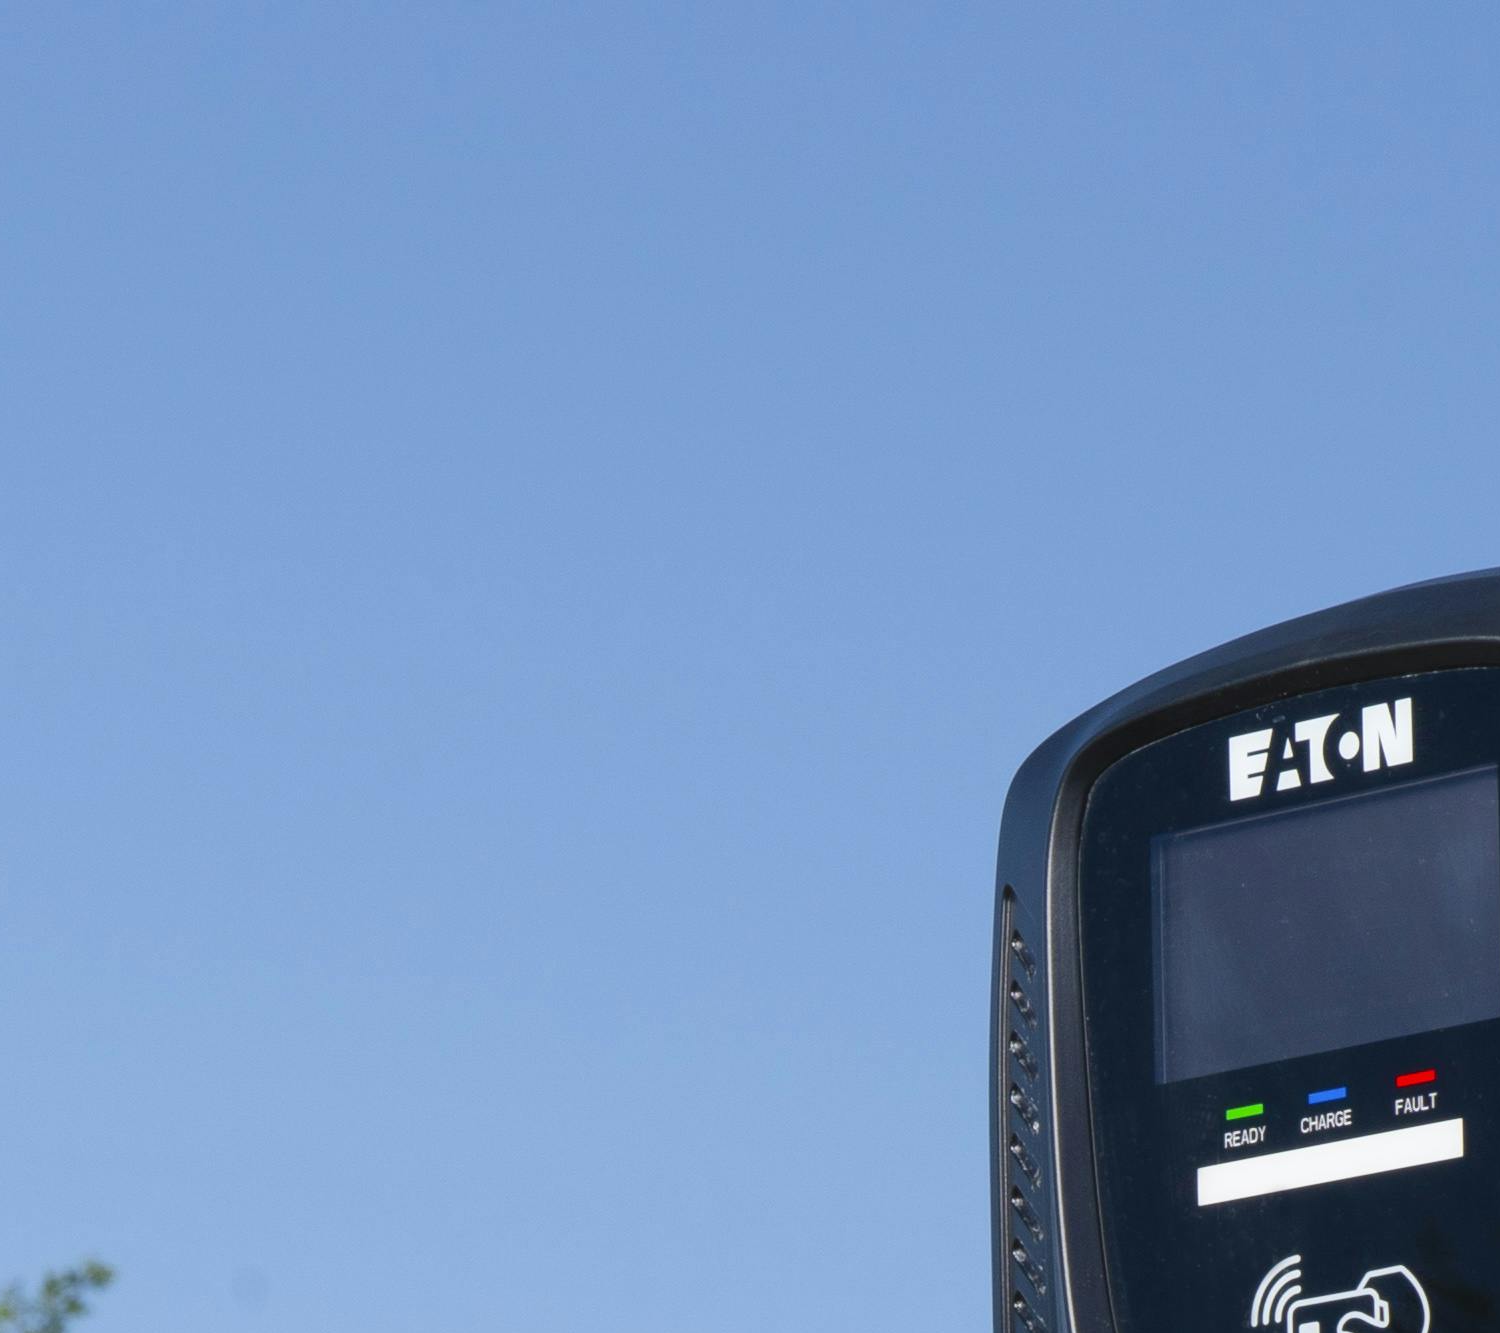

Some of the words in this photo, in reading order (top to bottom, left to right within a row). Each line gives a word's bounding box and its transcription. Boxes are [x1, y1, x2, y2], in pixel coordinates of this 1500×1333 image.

[1228, 697, 1414, 802] EATON
[1223, 1125, 1267, 1150] READY
[1300, 1108, 1353, 1134] CHARGE
[1394, 1091, 1438, 1116] FAULT
